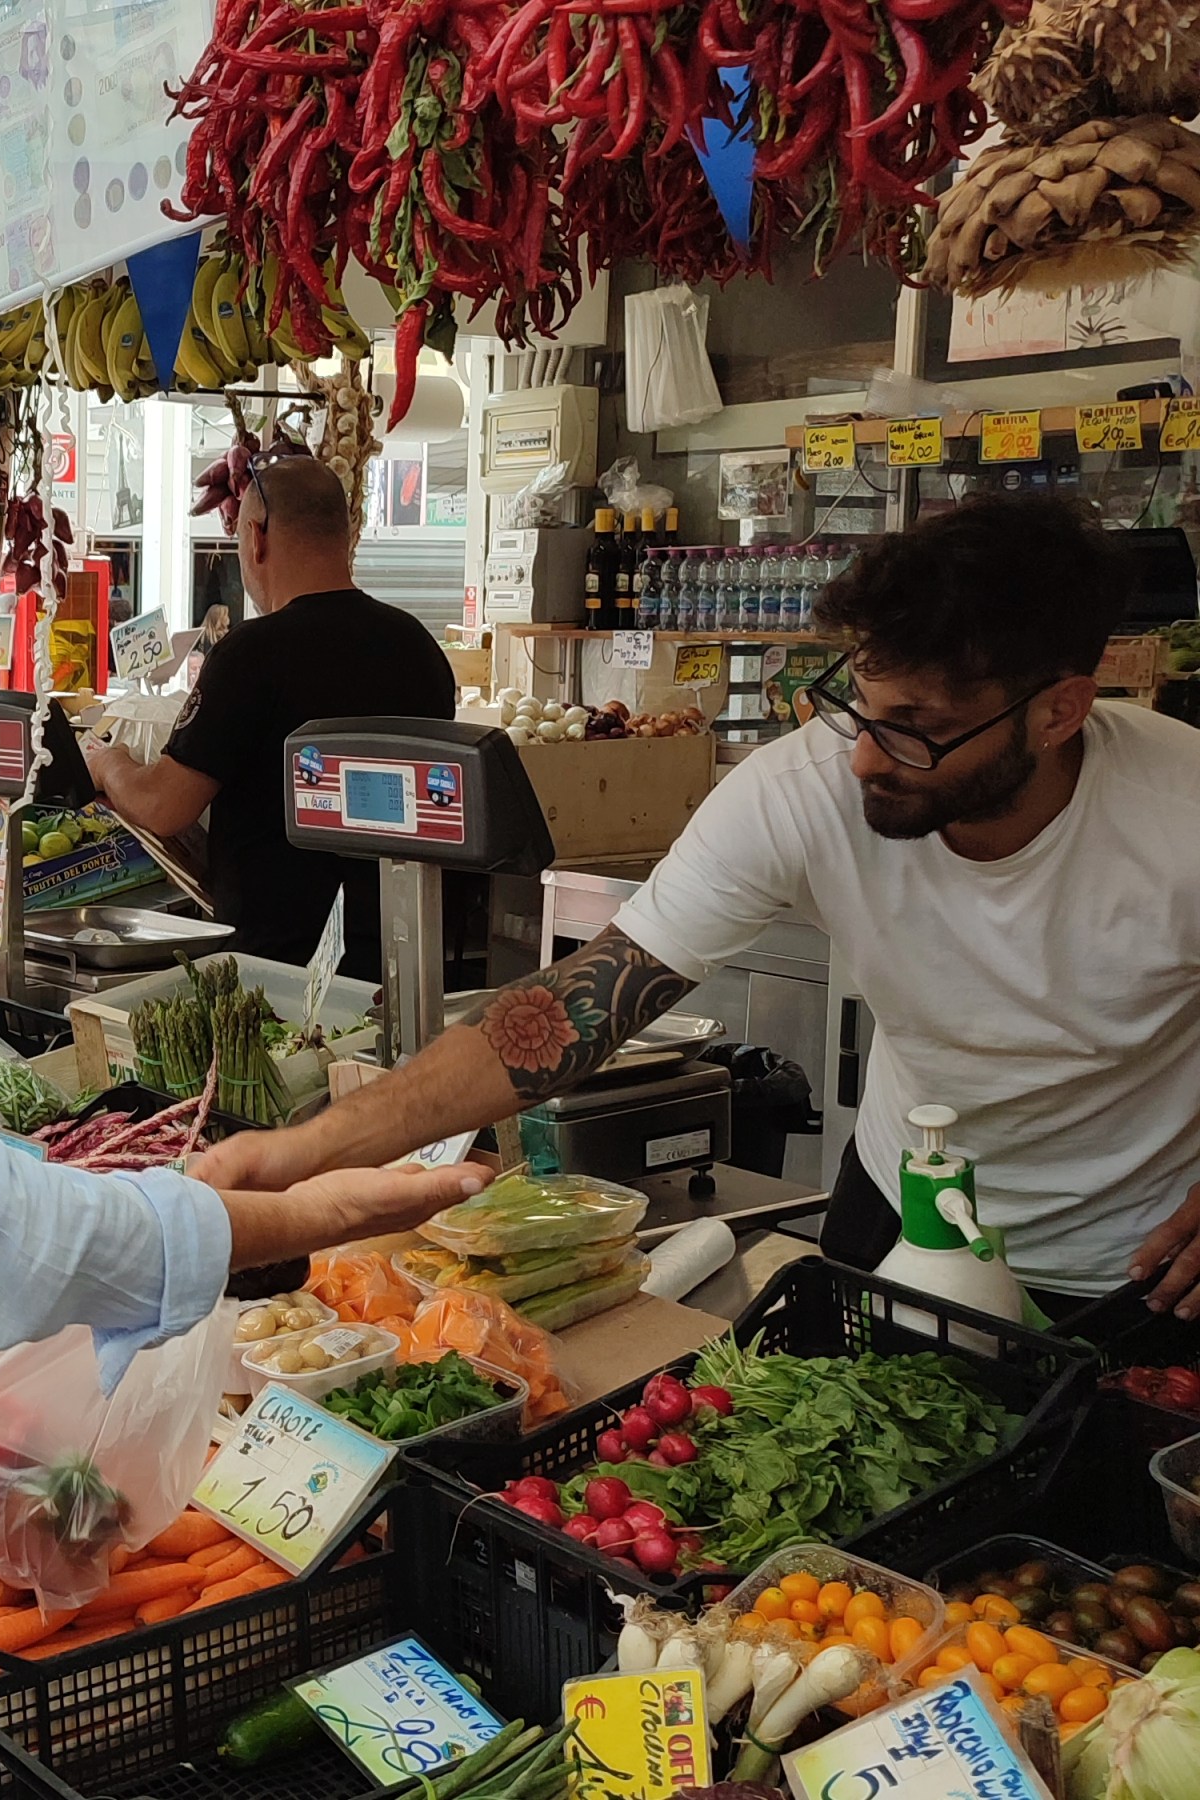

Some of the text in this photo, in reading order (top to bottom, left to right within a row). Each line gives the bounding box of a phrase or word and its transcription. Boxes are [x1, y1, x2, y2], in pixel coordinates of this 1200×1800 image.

[28, 873, 63, 896] FRUTTA
[64, 865, 81, 882] DEL
[82, 855, 112, 874] PONTE
[257, 1396, 323, 1442] CAROTE
[220, 1476, 314, 1540] 1,50
[575, 1693, 607, 1720] €
[640, 1679, 665, 1787] CIPOLLINA
[925, 1680, 1000, 1777] RADICCHIO
